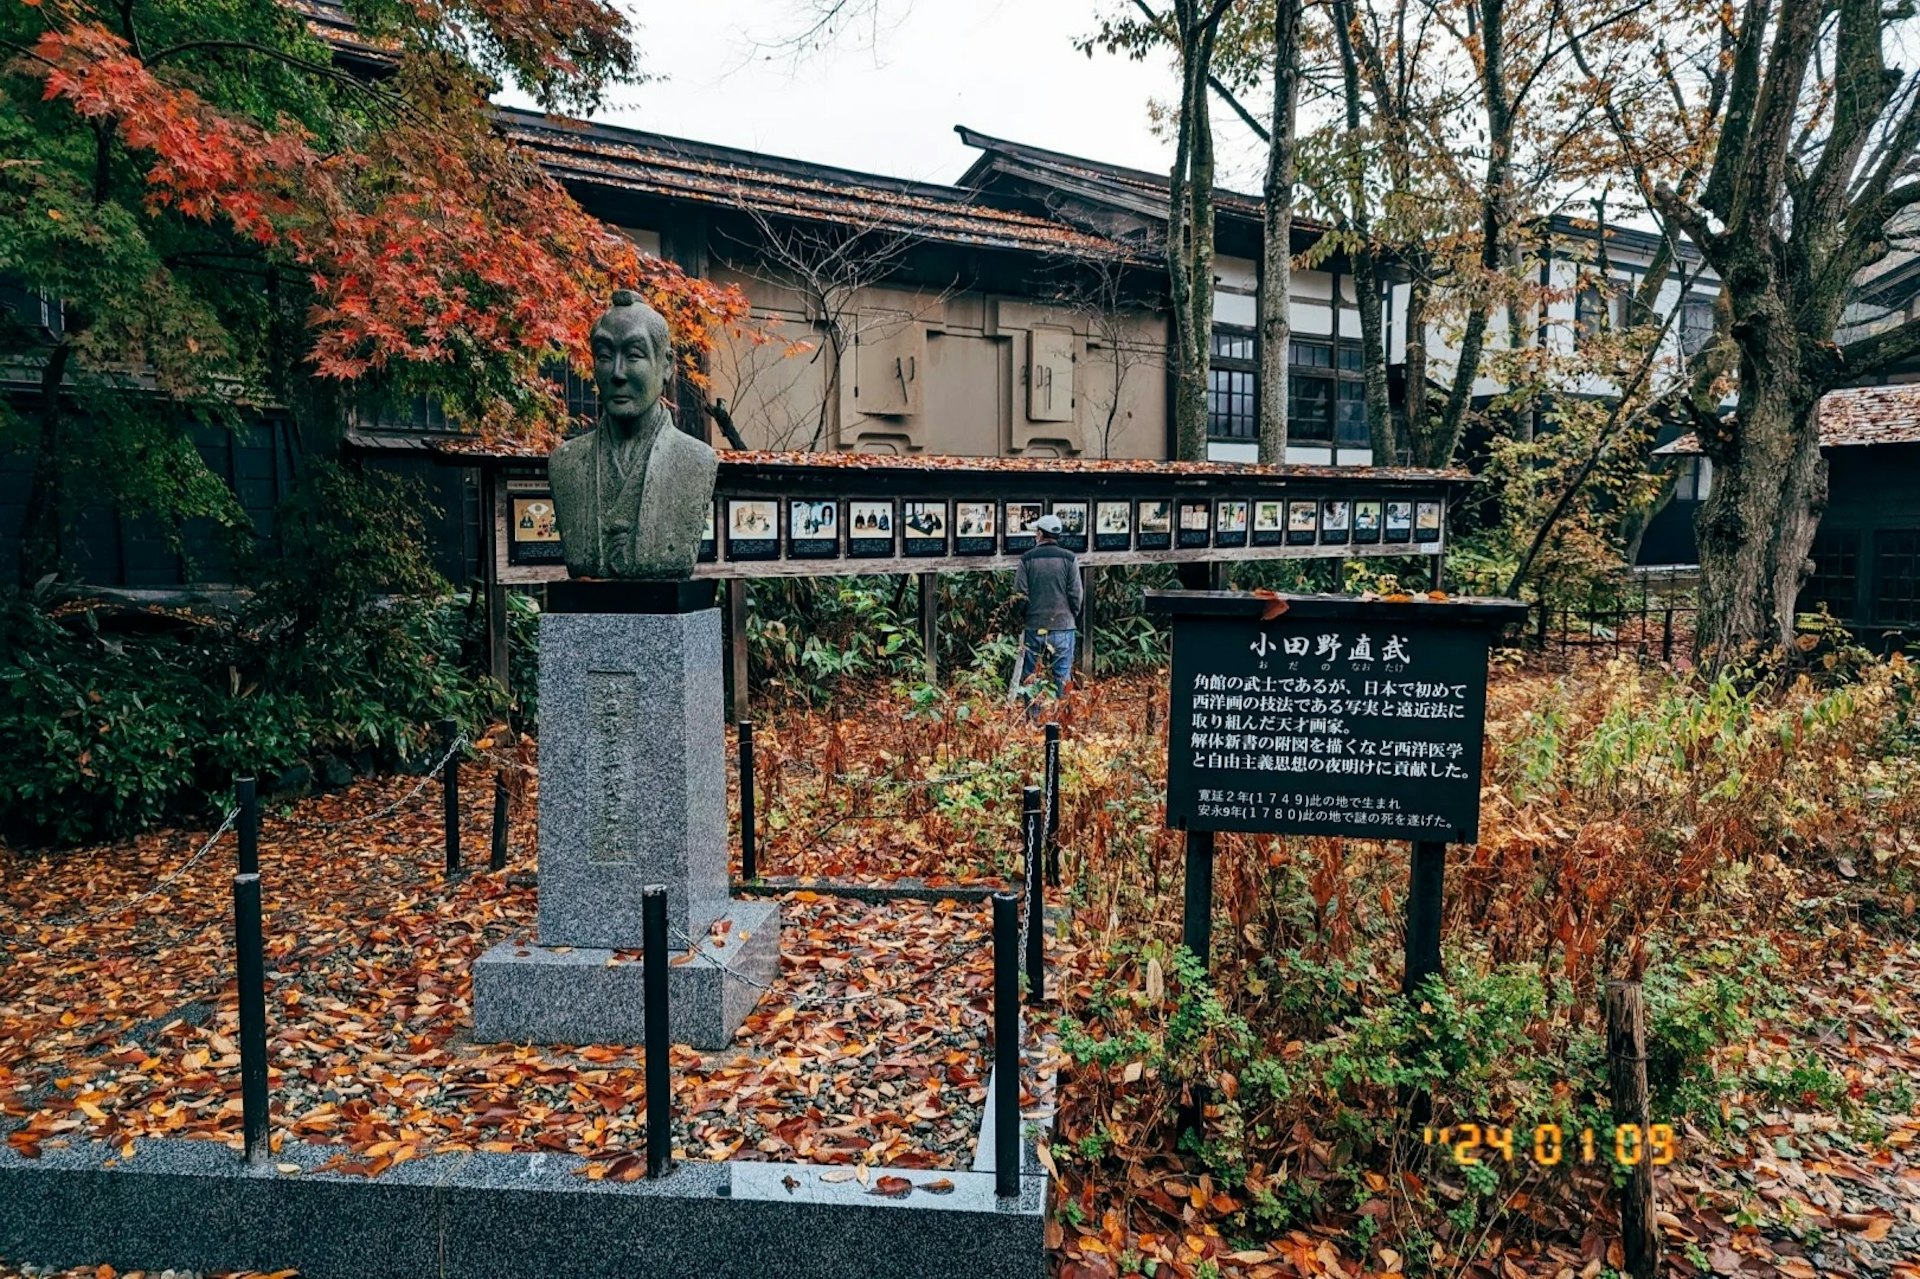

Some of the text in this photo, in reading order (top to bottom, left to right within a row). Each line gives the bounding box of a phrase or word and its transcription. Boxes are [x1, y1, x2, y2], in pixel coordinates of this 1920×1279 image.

[1250, 631, 1411, 664] 小田野直武
[1194, 673, 1467, 698] 角館の武士であるが、日本で初めて
[1192, 694, 1465, 719] 西洋画の技法である写実と遠近法に
[1191, 713, 1351, 734] 取り組んだ天才画家。
[1191, 733, 1463, 759] 解体新書の附図を描くなど西洋医学
[1191, 752, 1469, 779] と自由主義思想の夜明けに貢献した。
